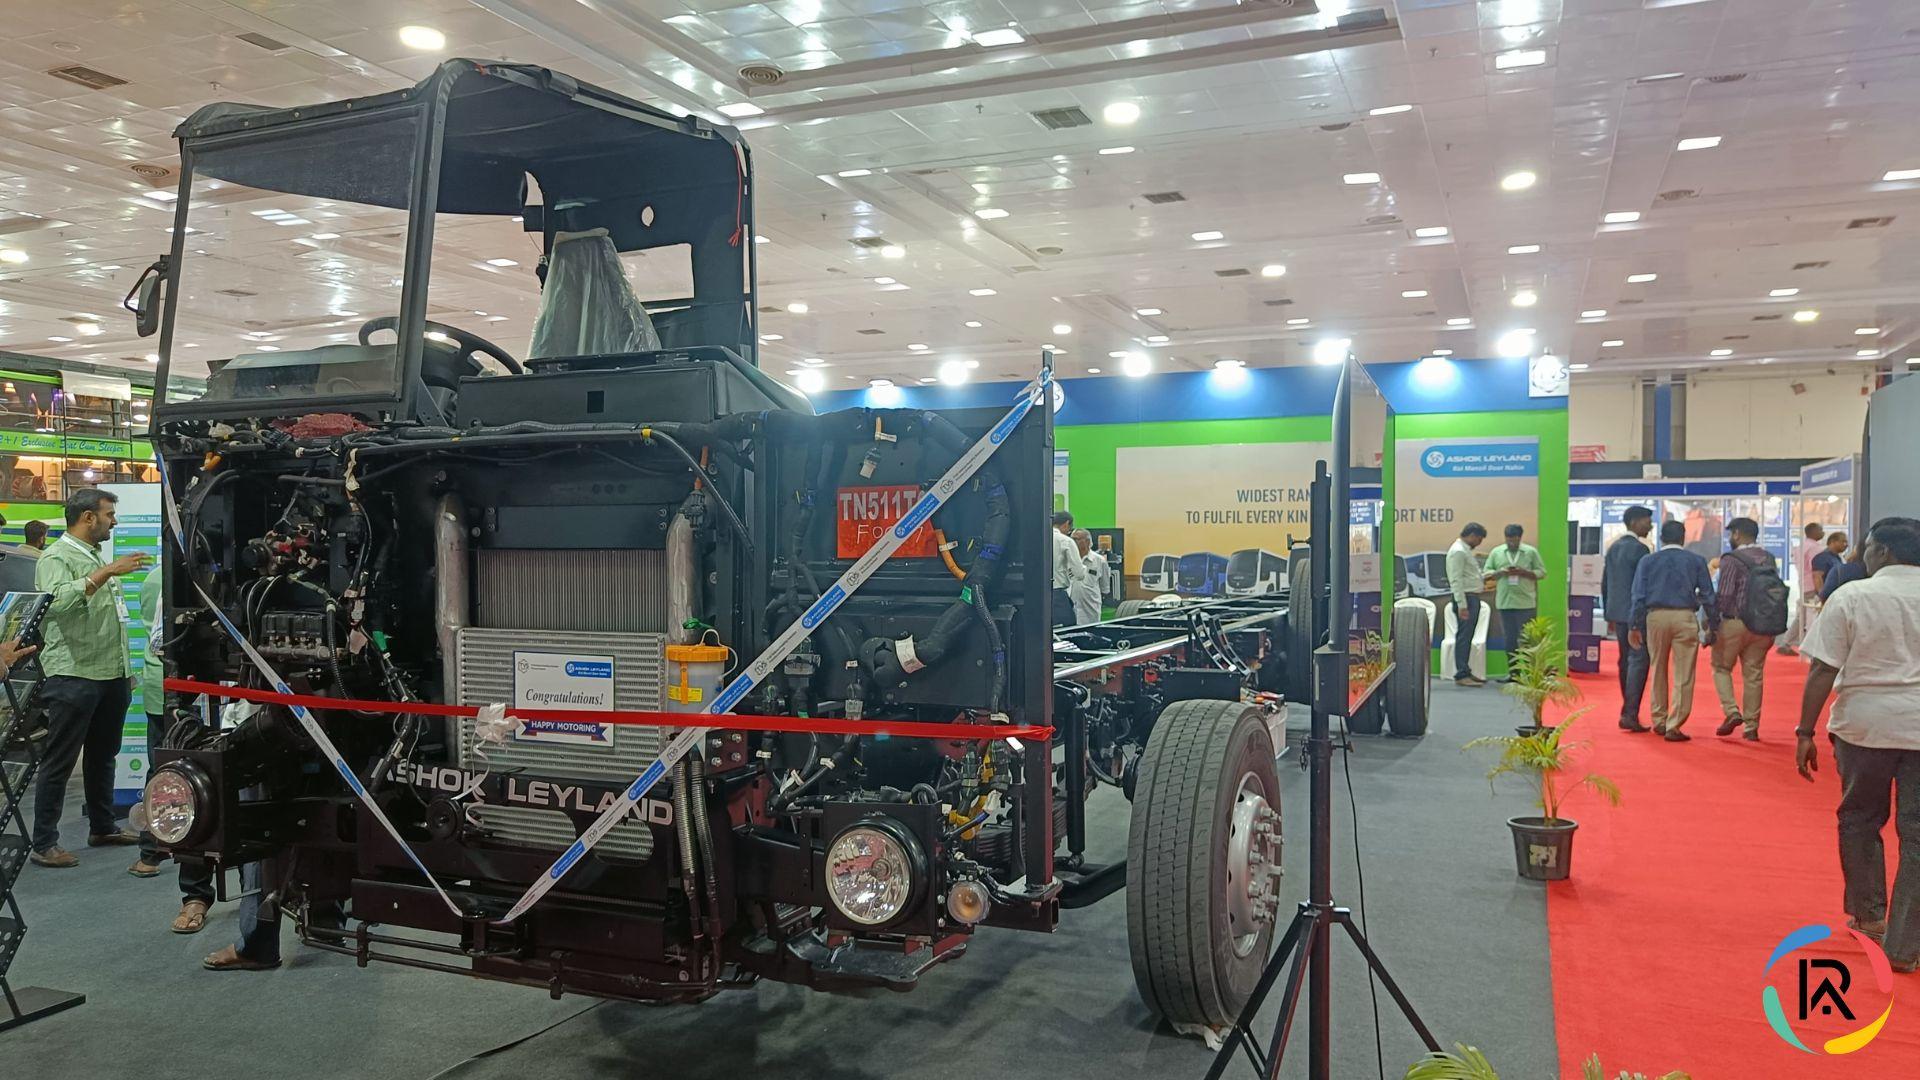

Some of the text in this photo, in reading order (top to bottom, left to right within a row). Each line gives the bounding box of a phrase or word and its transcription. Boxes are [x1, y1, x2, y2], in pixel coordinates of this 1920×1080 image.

[98, 442, 124, 453] Sleeper
[1446, 454, 1532, 463] ASHOK LEYLAND
[1236, 488, 1312, 503] WIDEST RAN
[840, 490, 922, 521] TN511T
[1186, 510, 1200, 524] TO
[1204, 510, 1242, 524] FULFIL
[1246, 510, 1284, 524] EVERY
[1287, 509, 1308, 523] KIN
[1420, 508, 1454, 522] NEED
[525, 688, 604, 706] Congratulations!
[531, 721, 597, 733] HAPPY MOTORING
[371, 758, 486, 798] ASHOK
[508, 777, 674, 827] LEYLAND
